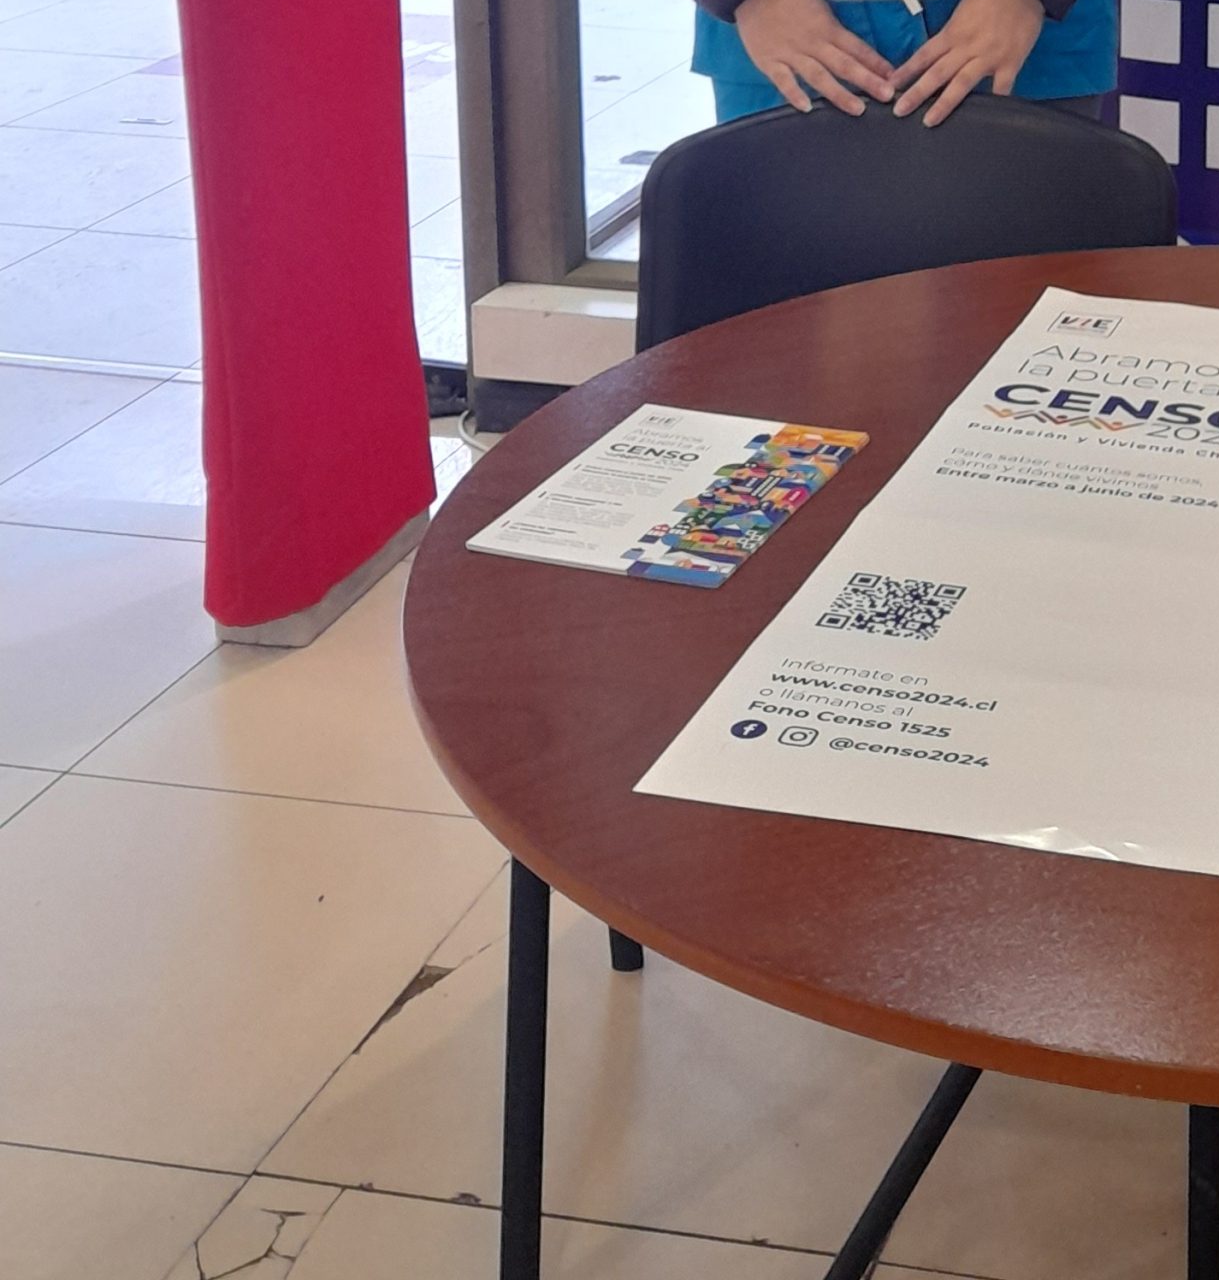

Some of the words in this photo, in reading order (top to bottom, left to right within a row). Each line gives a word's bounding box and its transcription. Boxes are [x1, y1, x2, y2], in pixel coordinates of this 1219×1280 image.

[1017, 359, 1054, 377] la
[610, 443, 700, 462] CENSO
[968, 421, 1068, 441] Población
[1077, 435, 1089, 445] y
[1098, 437, 1186, 455] Vivienda
[950, 447, 993, 460] Para
[1000, 452, 1050, 467] saber
[1055, 459, 1133, 477] cuántos
[936, 467, 991, 481] Entre
[995, 475, 1060, 490] marzo
[1074, 483, 1133, 498] junio
[1138, 491, 1165, 502] de
[1084, 473, 1160, 490] vivimos
[781, 658, 895, 682] Infórmate
[900, 675, 929, 687] en
[759, 688, 774, 697] o
[780, 688, 885, 714] llámanos
[892, 705, 914, 717] al
[771, 672, 998, 712] www.censo2024.cl
[747, 700, 809, 719] Fono
[817, 711, 892, 731] Censo
[900, 722, 952, 739] 1525
[829, 736, 990, 769] @censo2024
